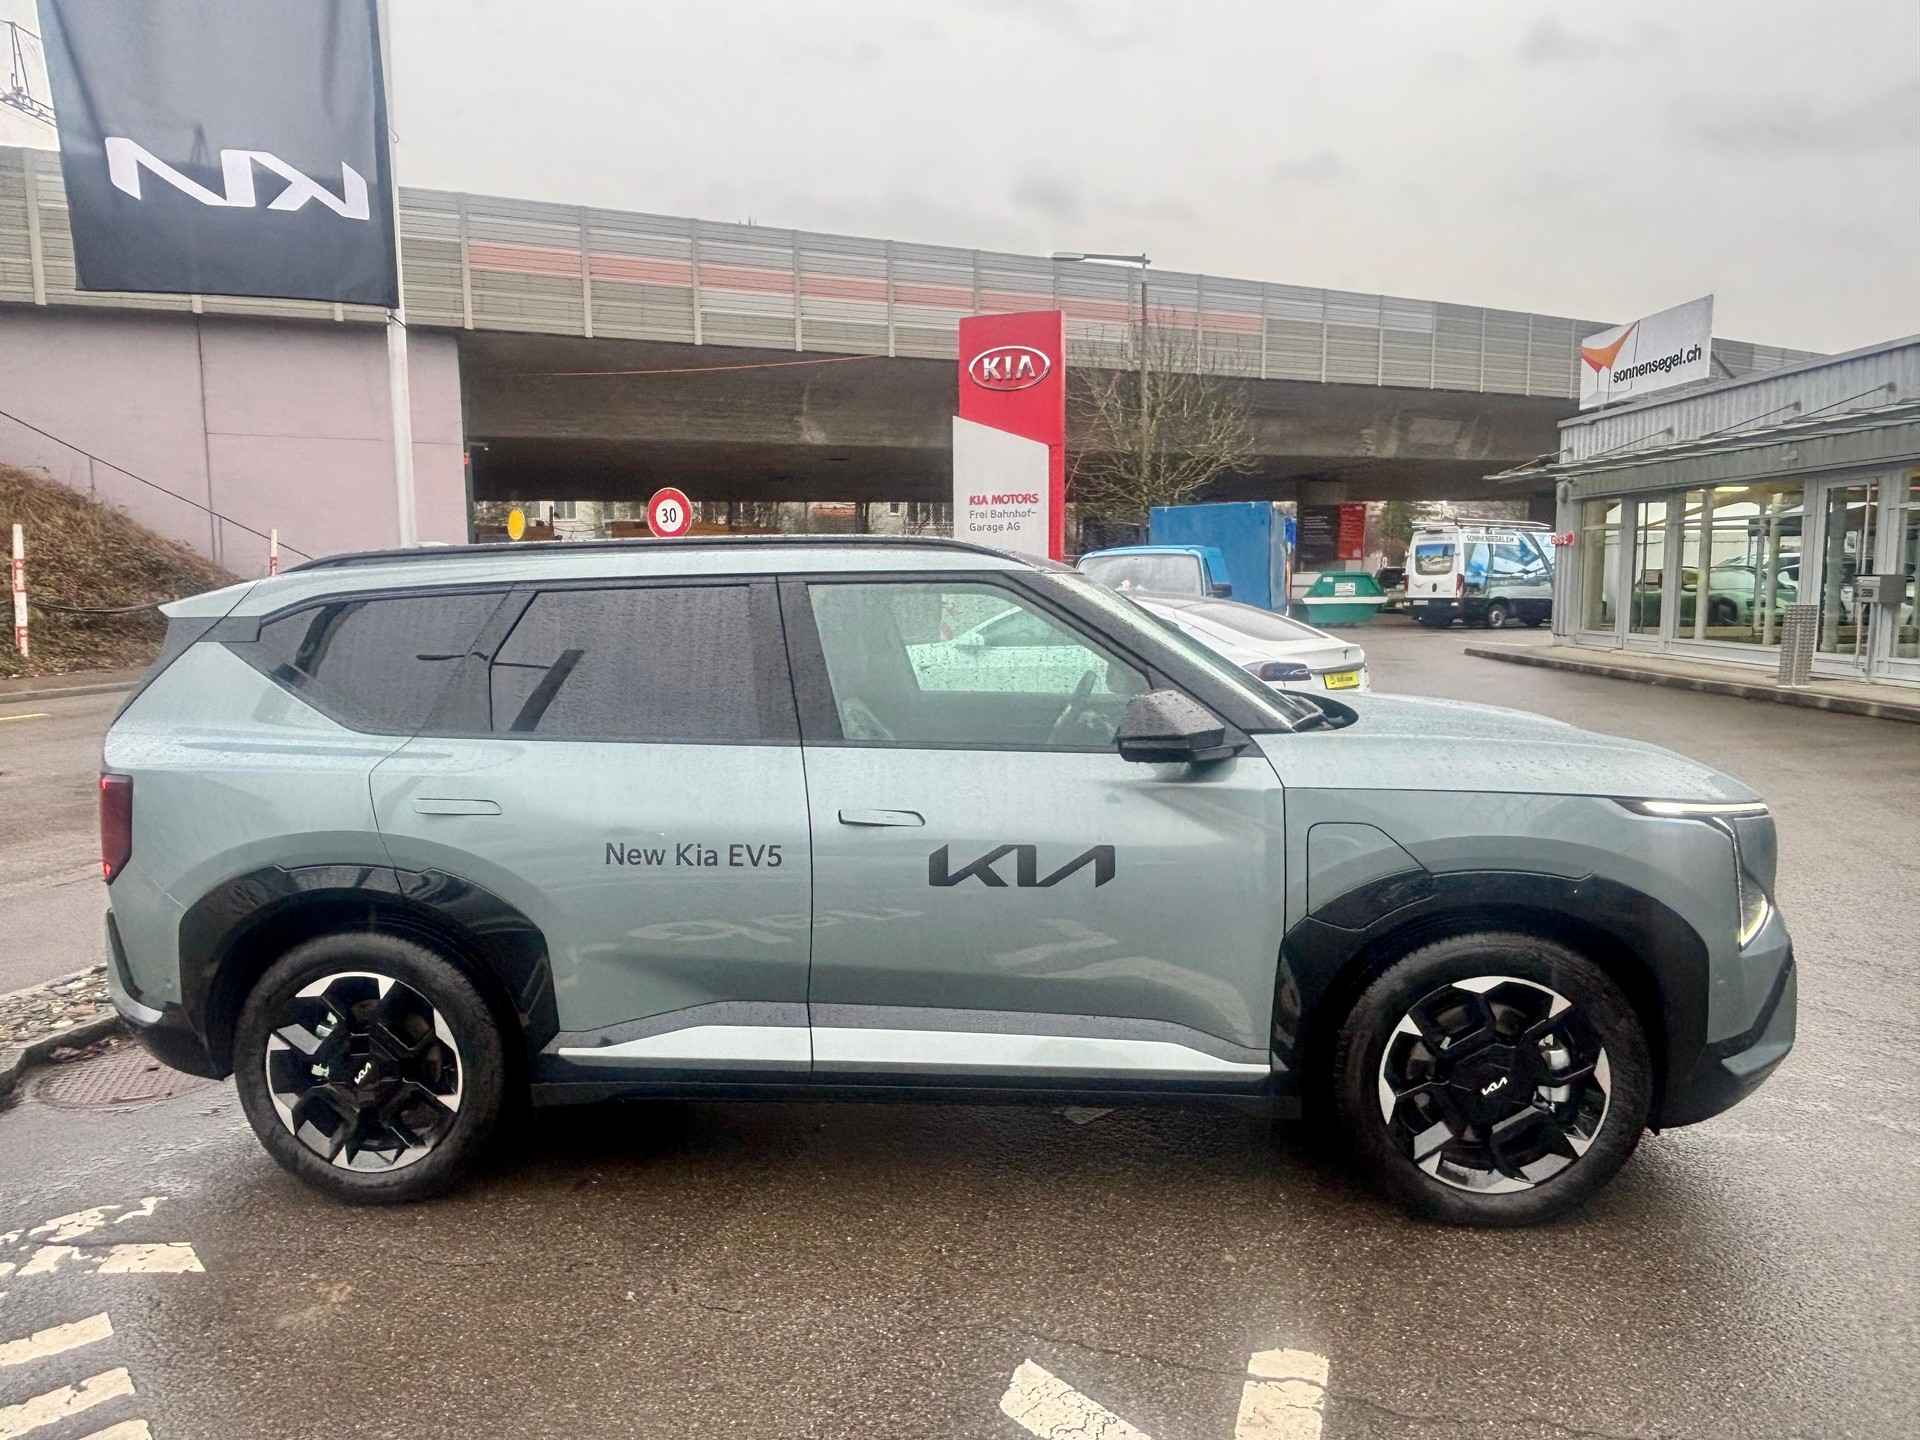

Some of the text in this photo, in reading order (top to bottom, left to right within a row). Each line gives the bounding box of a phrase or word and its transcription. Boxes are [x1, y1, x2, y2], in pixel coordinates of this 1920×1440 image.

[983, 355, 1036, 381] KIA
[1613, 344, 1702, 383] sonnensegel.ch
[969, 493, 1039, 506] KIA MOTORS
[662, 507, 677, 524] 30
[969, 508, 1037, 519] Frei Bahnhof-
[969, 521, 1021, 533] Garage AG
[605, 842, 782, 867] New Kia EV5
[928, 843, 1116, 888] KIA
